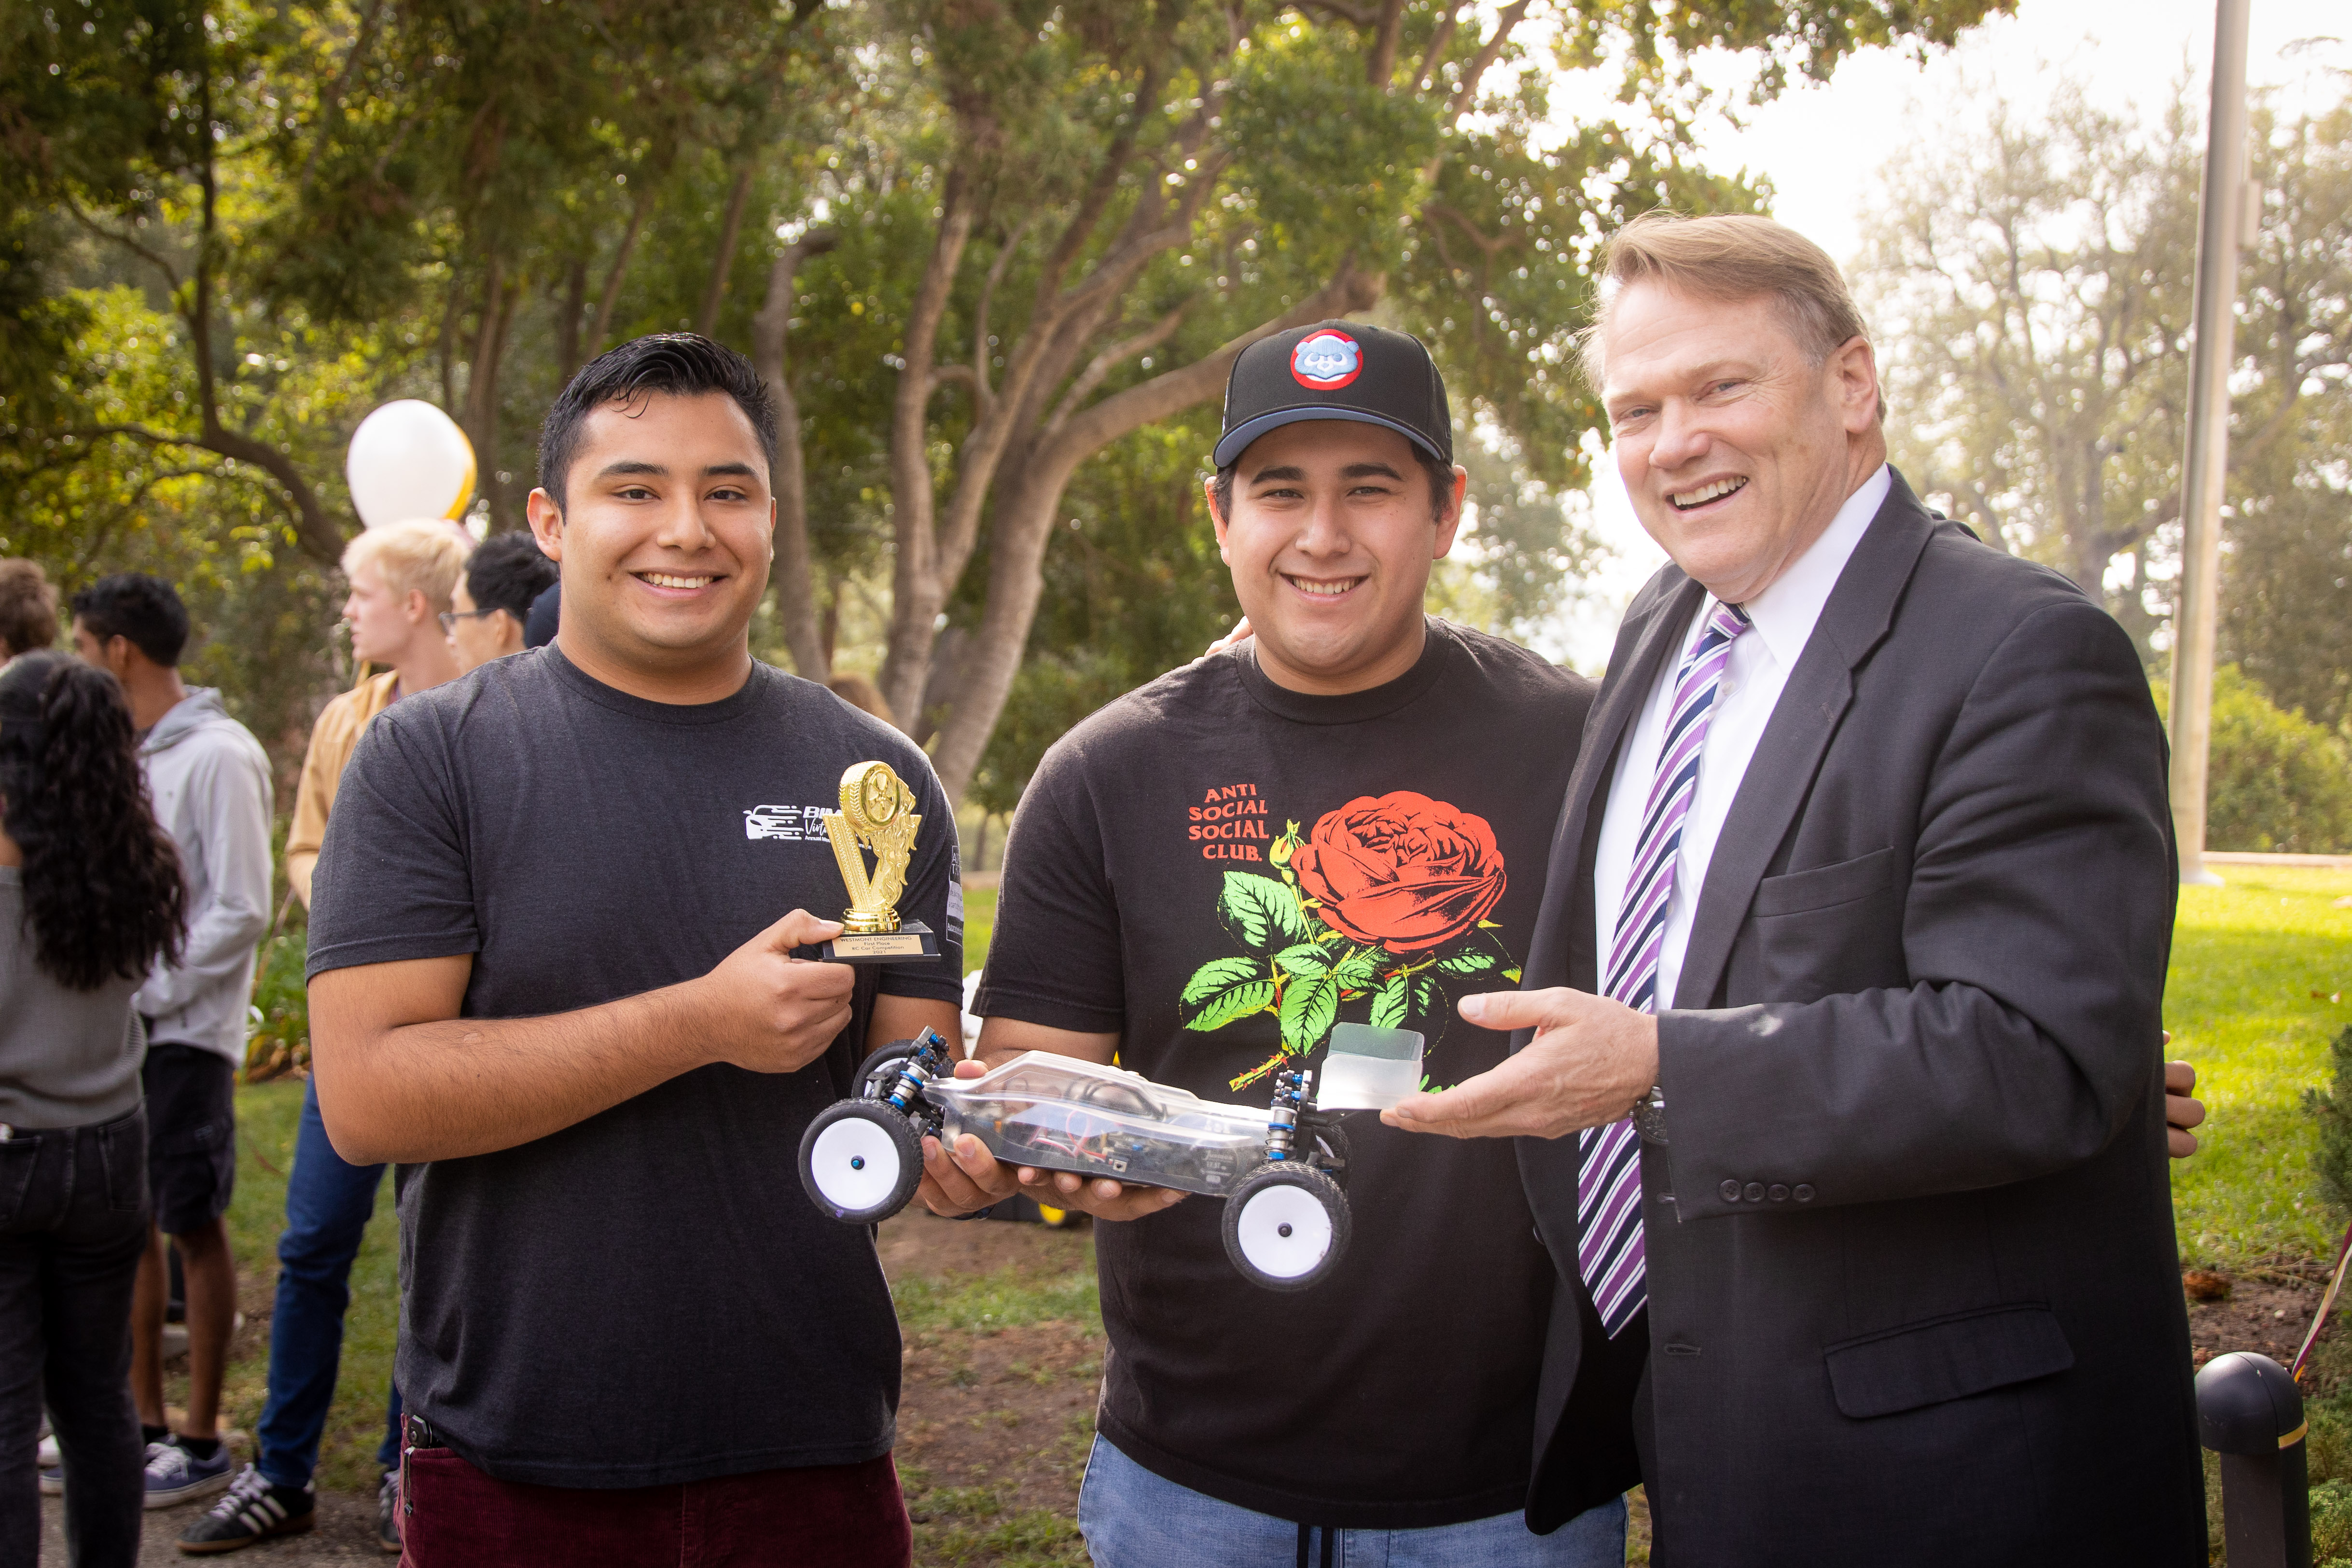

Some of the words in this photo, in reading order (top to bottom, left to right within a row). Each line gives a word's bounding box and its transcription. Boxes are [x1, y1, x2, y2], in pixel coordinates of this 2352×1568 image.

[1204, 784, 1257, 803] ANTI
[1189, 800, 1268, 821] SOCIAL
[1188, 819, 1269, 840] SOCIAL
[1202, 844, 1263, 861] CLUB.
